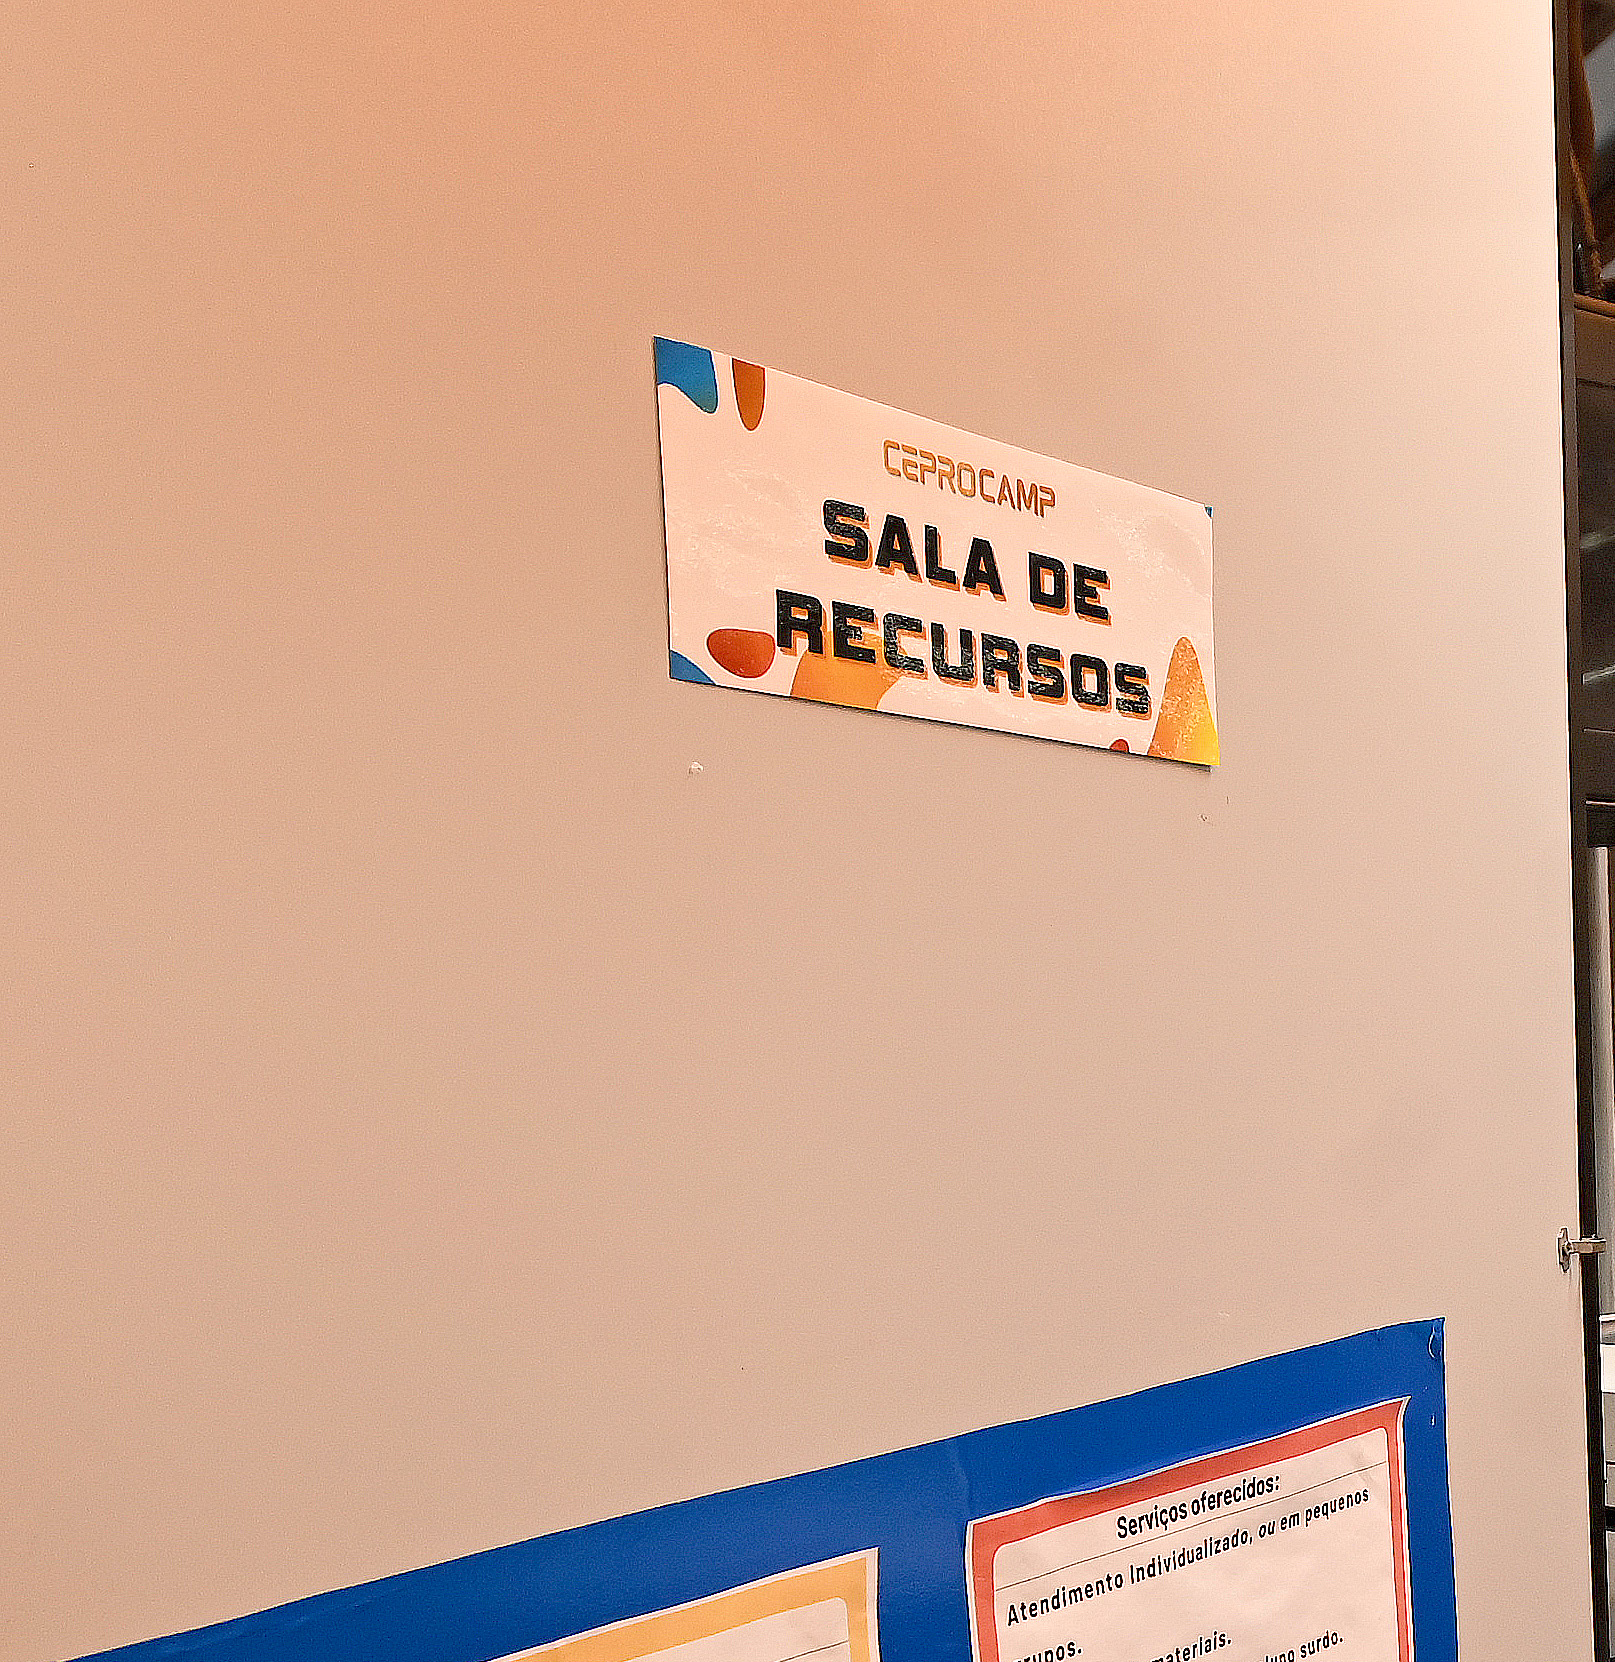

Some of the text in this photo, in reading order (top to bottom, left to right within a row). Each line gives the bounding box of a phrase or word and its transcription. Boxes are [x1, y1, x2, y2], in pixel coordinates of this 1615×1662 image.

[883, 439, 1055, 518] CEPROCAMP
[824, 499, 1111, 625] SALA DE
[776, 590, 1151, 720] RECURSOS
[1008, 1489, 1368, 1626] Atendimento Individualizado, ou em pequenos
[1117, 1475, 1280, 1538] Serviços oferecidos:
[1301, 1630, 1343, 1658] surdo.
